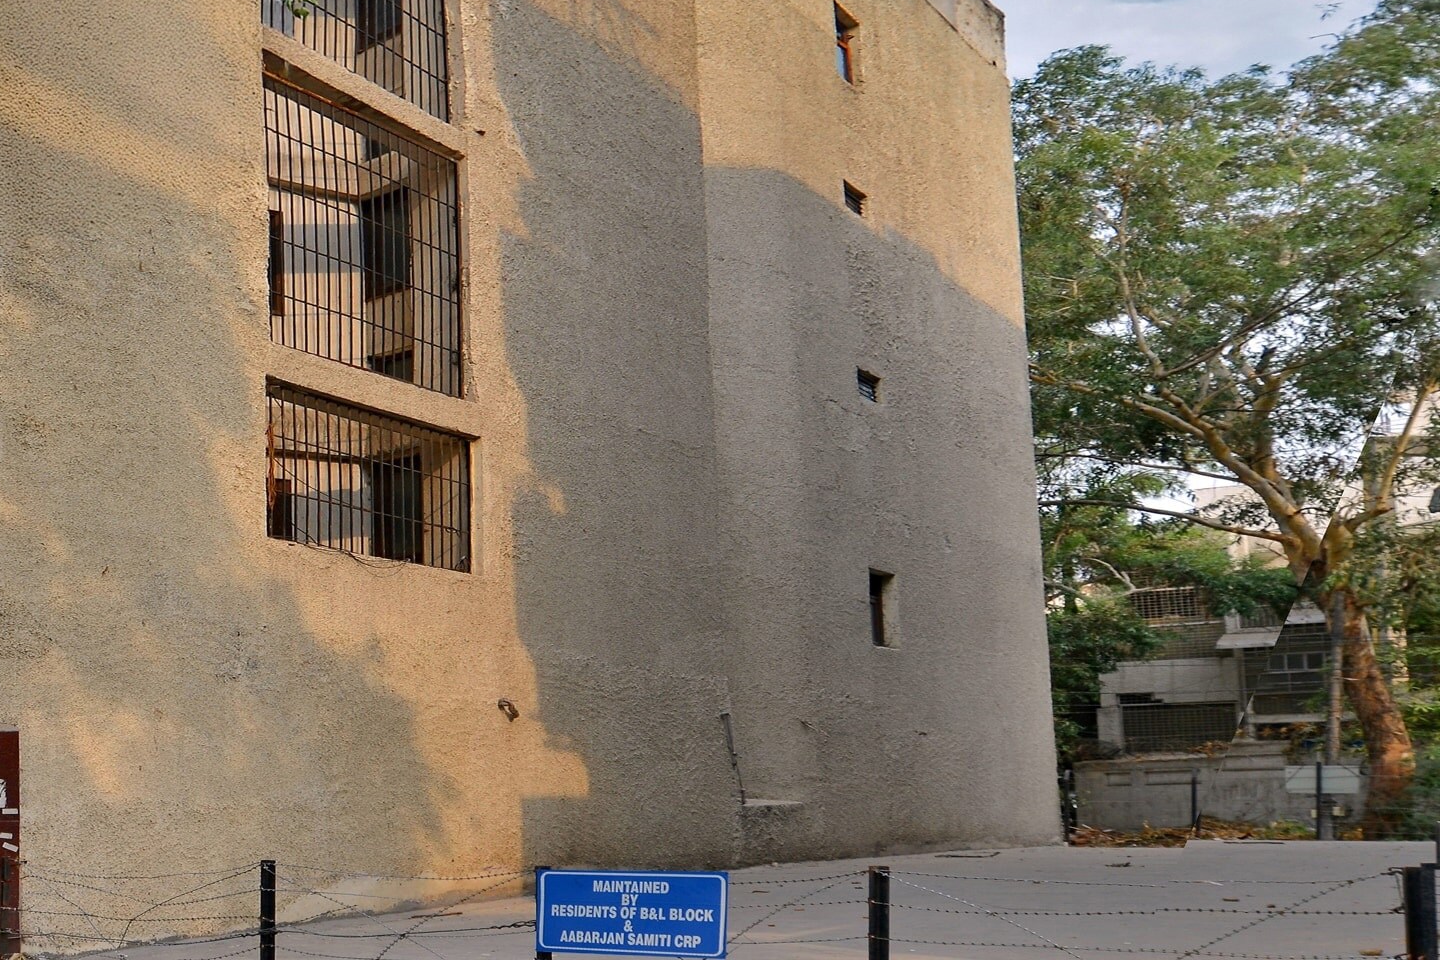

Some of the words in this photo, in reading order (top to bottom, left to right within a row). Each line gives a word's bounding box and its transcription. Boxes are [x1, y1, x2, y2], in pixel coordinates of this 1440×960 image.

[593, 880, 669, 894] MAINTAINED
[621, 894, 639, 906] BY
[551, 904, 617, 919] RESIDENTS
[620, 906, 637, 920] OF
[640, 907, 666, 921] B&L
[669, 908, 714, 922] BLOCK
[623, 920, 634, 932] &
[560, 930, 624, 945] AABARJAN
[627, 932, 671, 947] SAMITI
[674, 935, 702, 949] CRP
